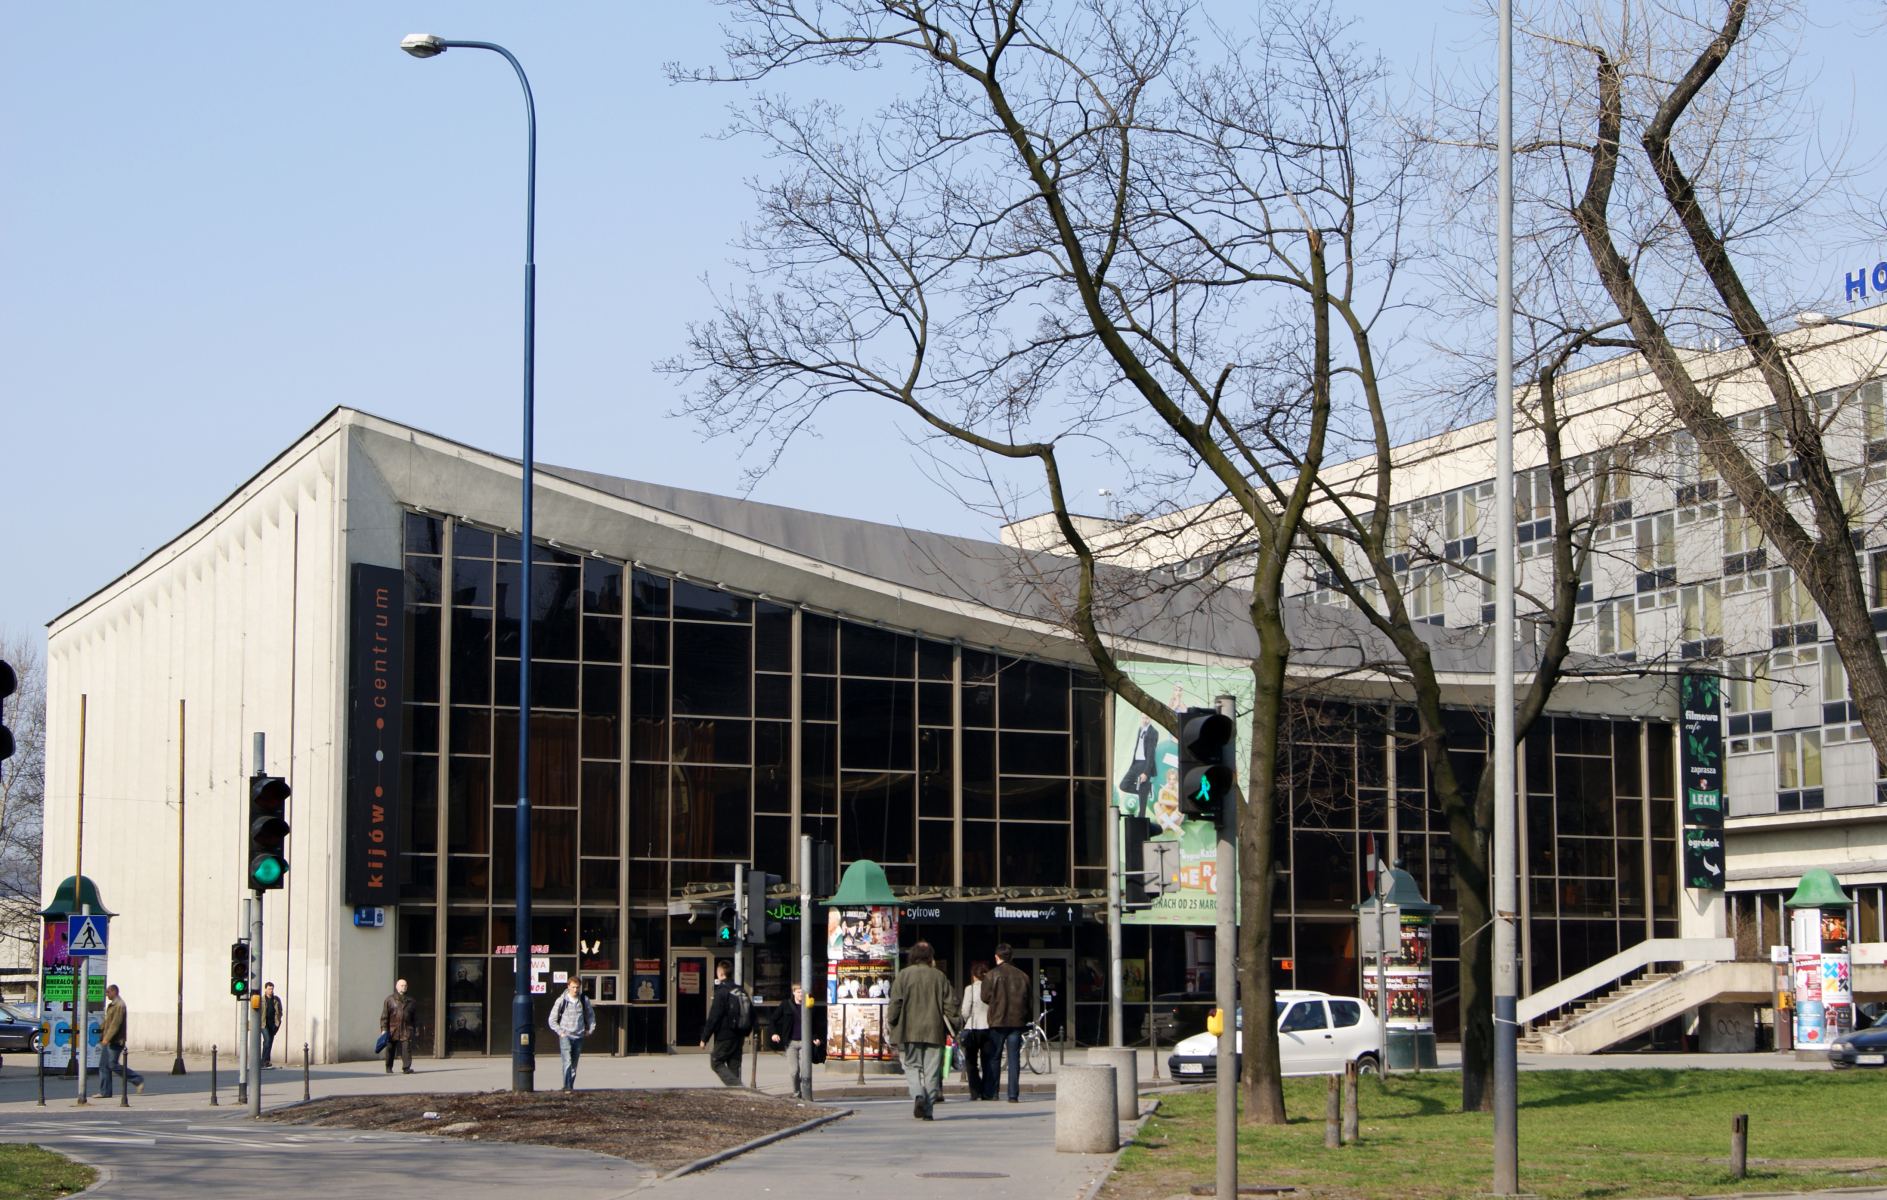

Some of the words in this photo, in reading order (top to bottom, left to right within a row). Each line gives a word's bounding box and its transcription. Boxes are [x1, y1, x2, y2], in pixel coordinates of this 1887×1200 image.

[372, 586, 389, 708] centrum
[1685, 710, 1718, 721] filmowa
[1685, 721, 1701, 734] cafe
[1690, 766, 1717, 776] zaprasza
[1692, 793, 1717, 806] LECH
[367, 804, 386, 888] kijów
[1688, 838, 1720, 848] ogródek
[1178, 899, 1188, 910] OD
[1189, 900, 1198, 910] 25
[1199, 899, 1217, 910] MARC
[906, 905, 940, 920] cyfrowe
[994, 906, 1039, 919] filmowa
[1039, 907, 1056, 920] cafe
